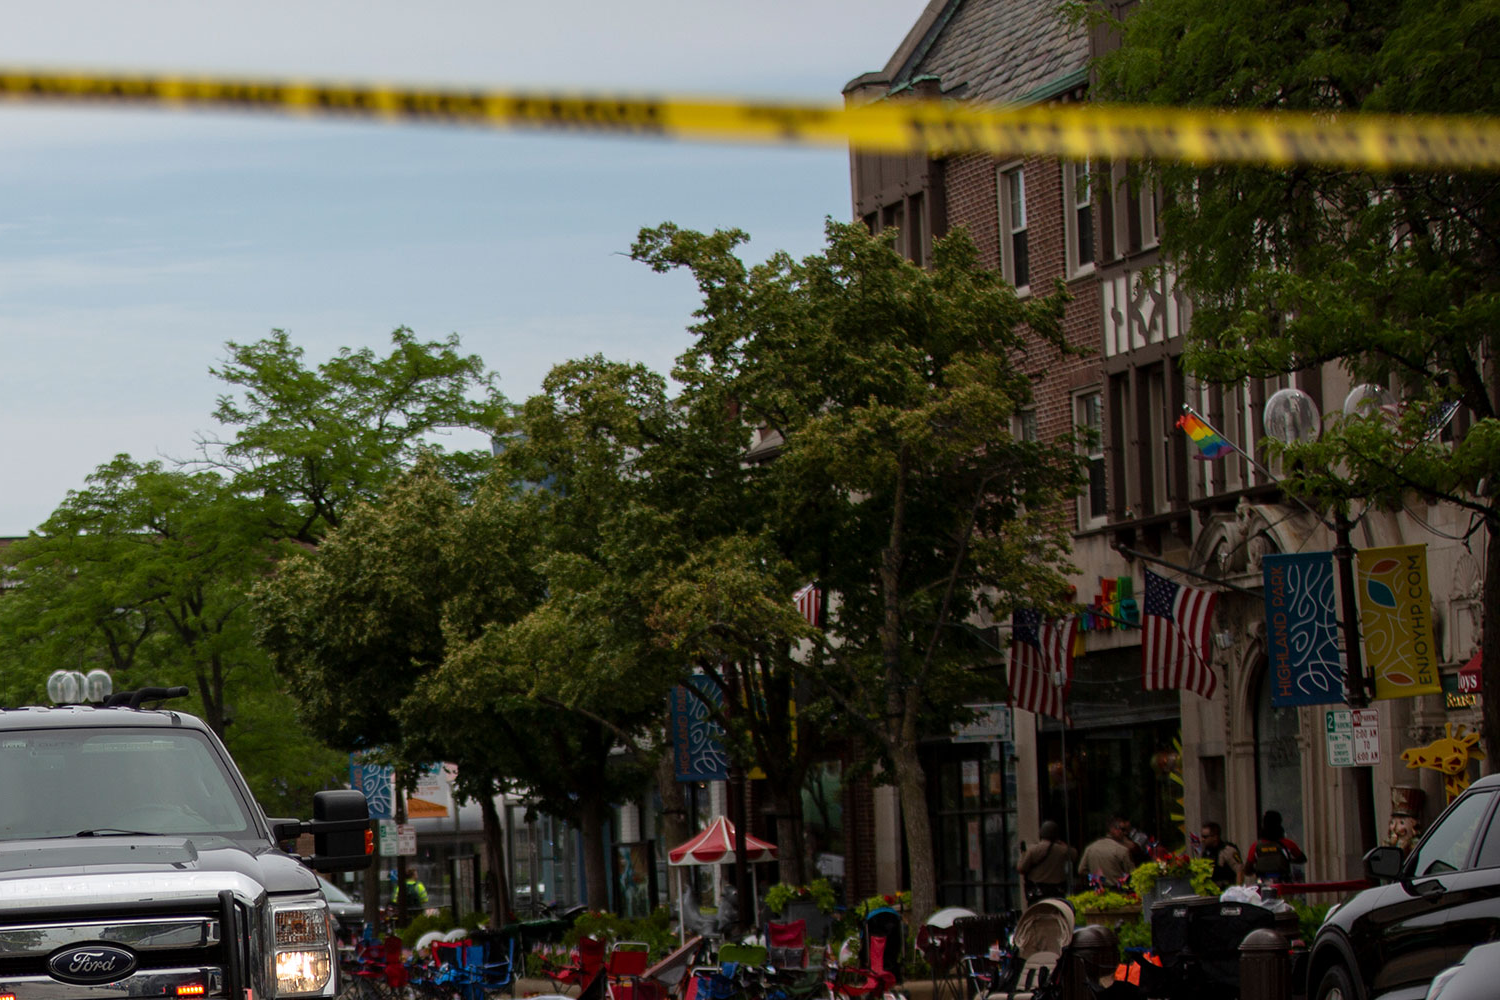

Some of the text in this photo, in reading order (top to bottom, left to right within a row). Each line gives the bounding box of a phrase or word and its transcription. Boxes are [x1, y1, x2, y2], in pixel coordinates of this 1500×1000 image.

[1270, 565, 1293, 697] HIGHLAND PARK
[1407, 555, 1432, 685] ENJOYHP.COM
[69, 952, 116, 973] Ford
